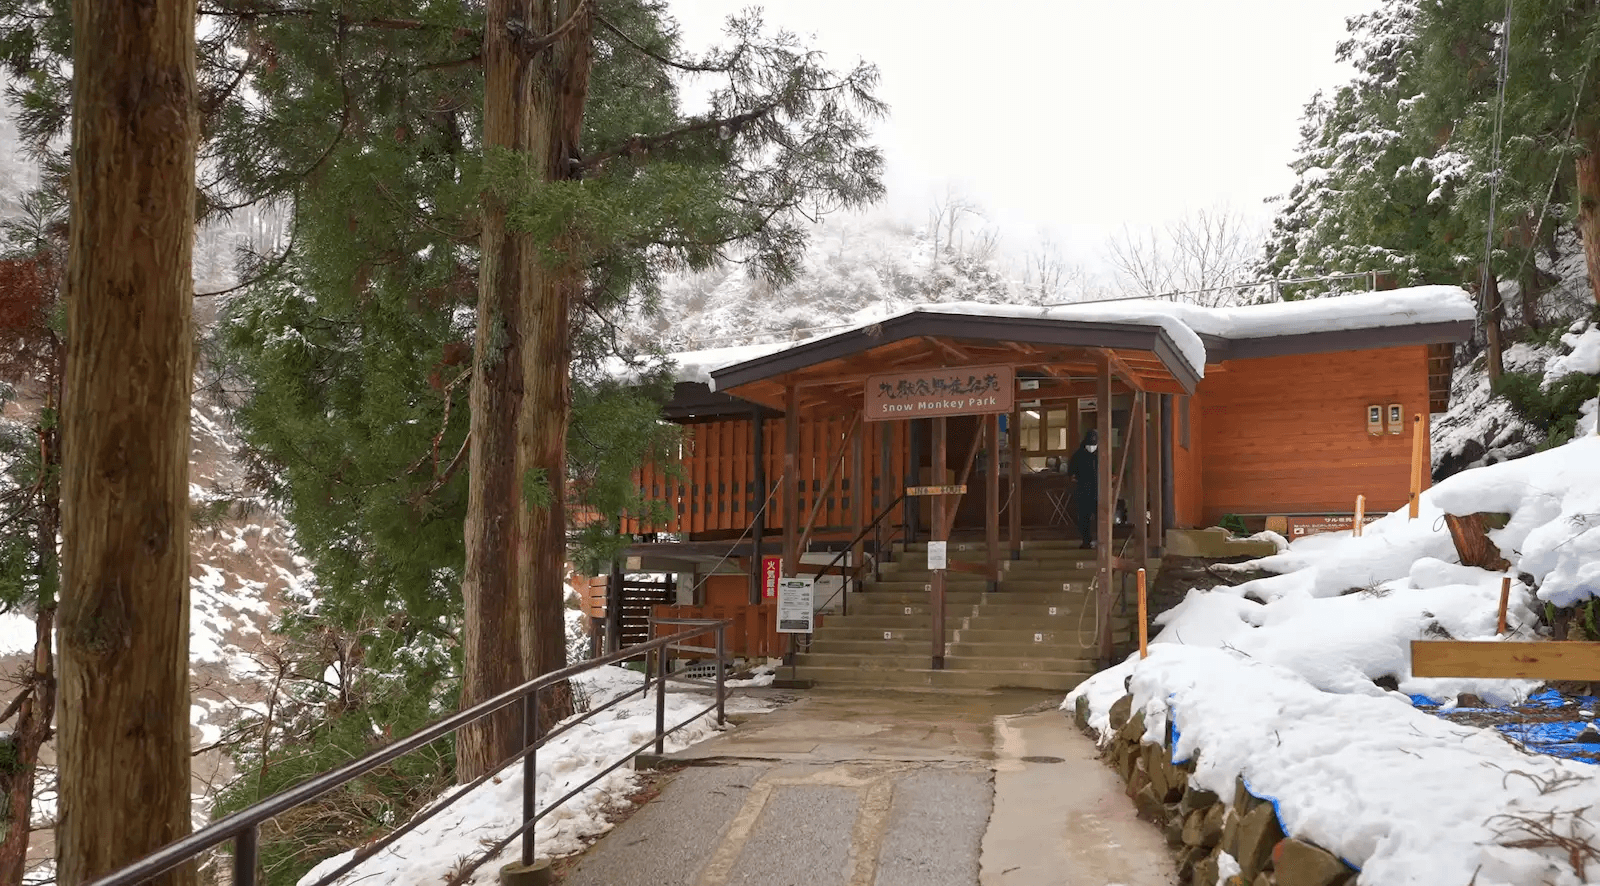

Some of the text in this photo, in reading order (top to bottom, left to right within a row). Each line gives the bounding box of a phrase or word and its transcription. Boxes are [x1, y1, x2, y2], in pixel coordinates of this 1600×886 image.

[882, 396, 997, 412] Snow Monkey Park
